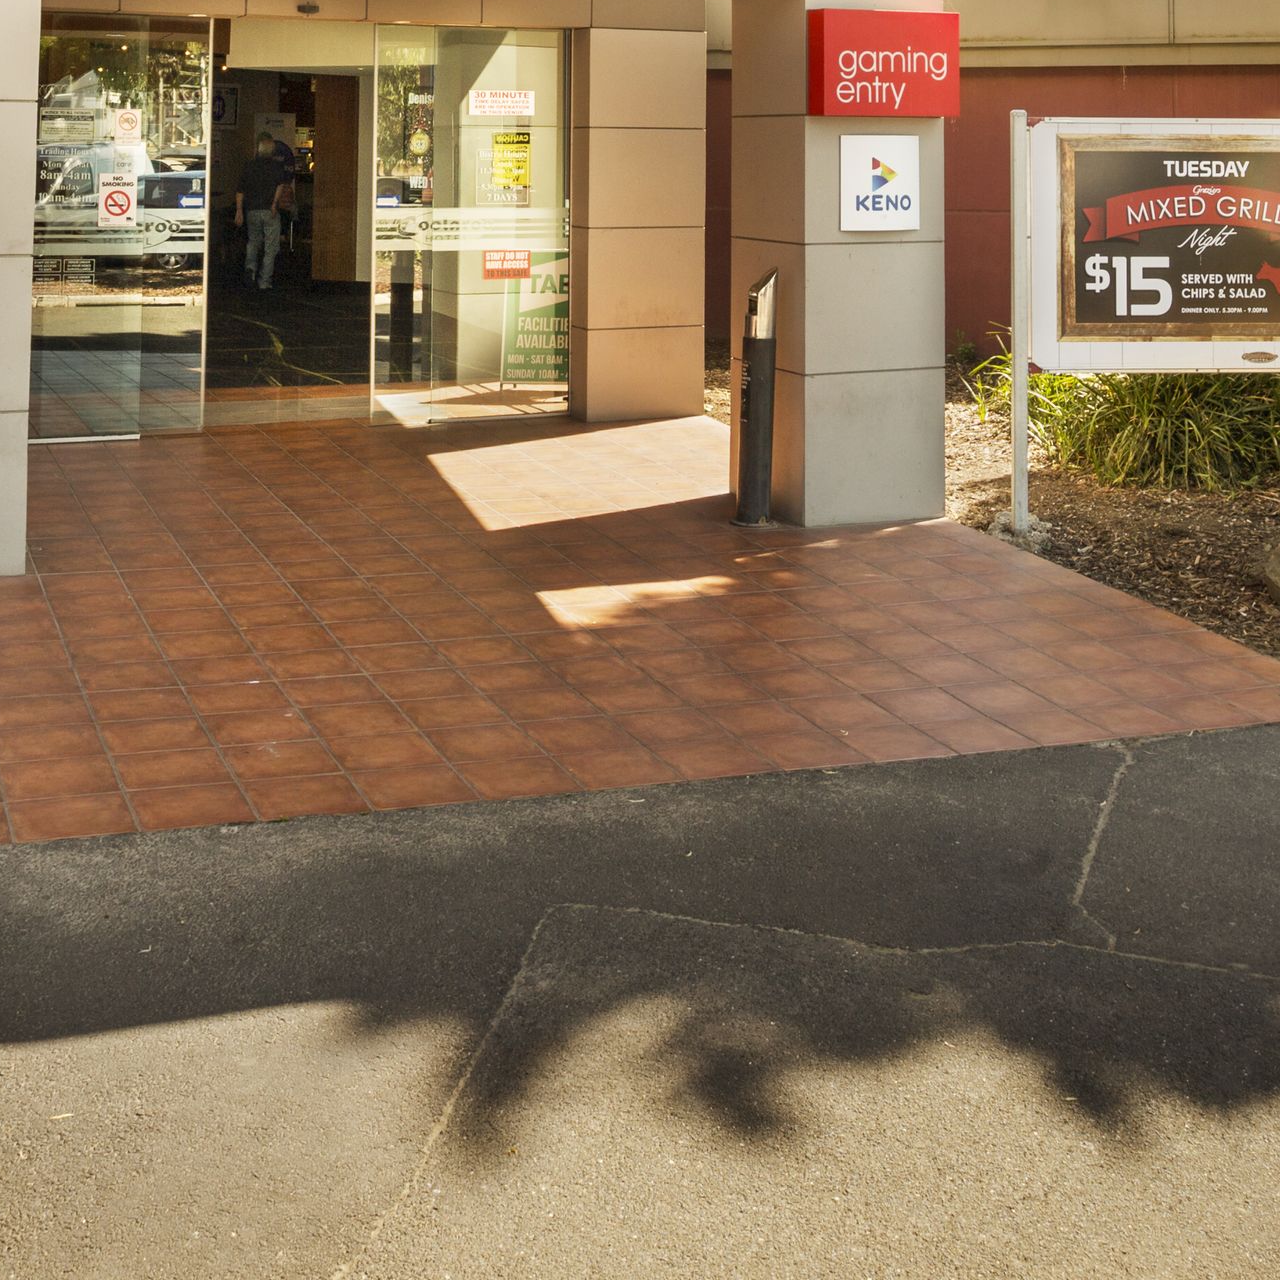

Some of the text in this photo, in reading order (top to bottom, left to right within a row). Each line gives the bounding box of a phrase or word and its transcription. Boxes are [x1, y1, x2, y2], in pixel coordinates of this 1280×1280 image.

[838, 46, 948, 80] gaming
[474, 91, 530, 99] 30 MINUTE
[836, 76, 906, 109] entry
[40, 148, 70, 156] Trading
[1163, 160, 1250, 178] TUESDAY
[409, 176, 427, 189] WED
[487, 193, 518, 201] 7 DAYS
[856, 194, 911, 211] KENO
[1126, 195, 1206, 225] MIXED
[1177, 225, 1237, 255] Night
[485, 251, 529, 260] STAFF DO NOT
[502, 260, 529, 269] ACCESS
[1084, 253, 1173, 316] $15
[1181, 273, 1253, 284] SERVED WITH
[1181, 287, 1266, 299] CHIPS & SALAD
[507, 354, 524, 364] MON
[530, 354, 544, 364] SAT
[546, 354, 563, 364] 8AM
[506, 369, 535, 379] SUNDAY
[539, 369, 559, 379] 10AM
